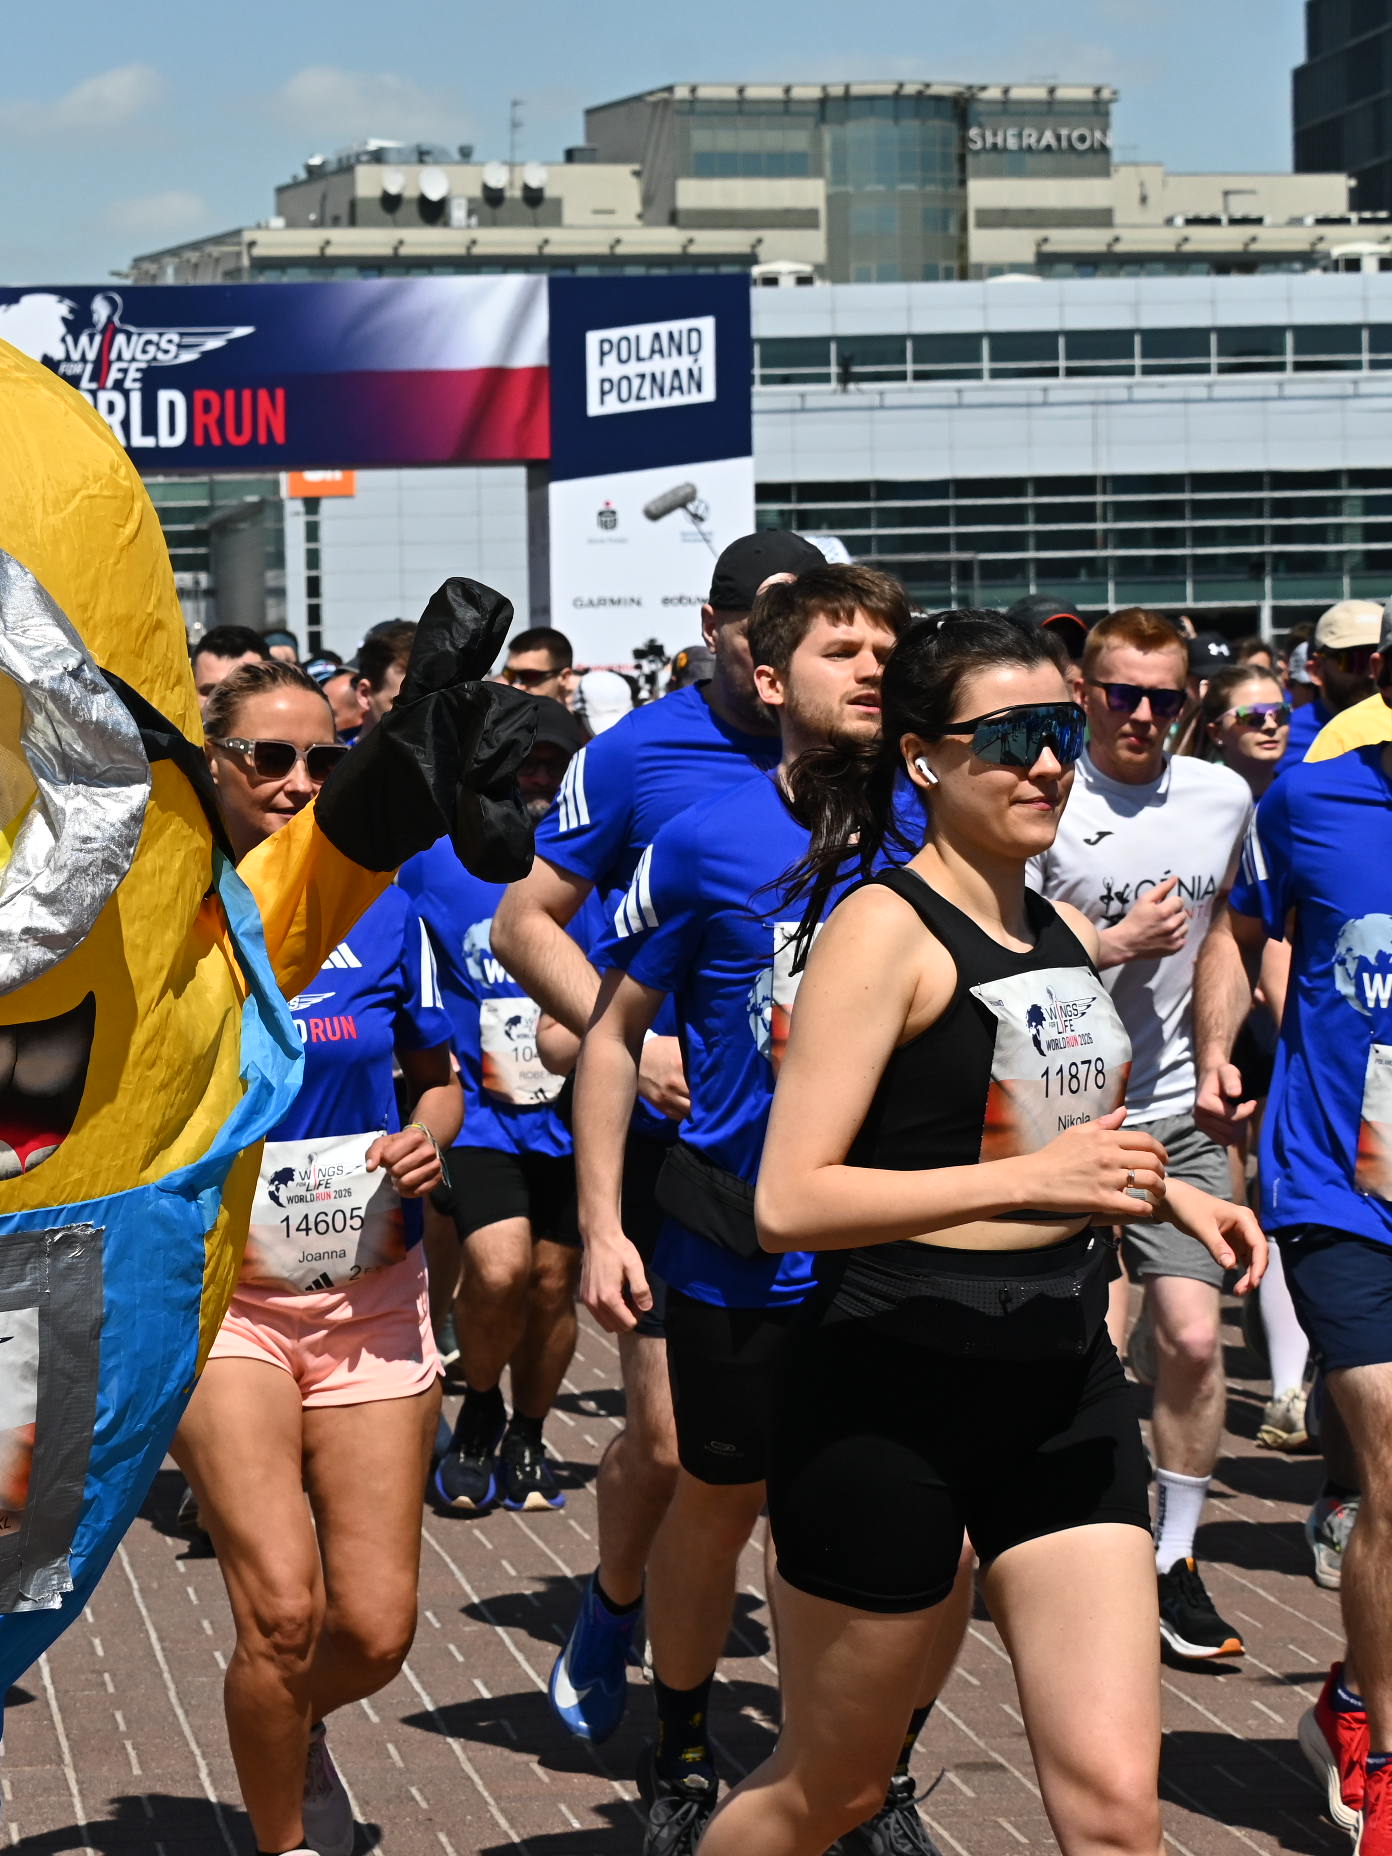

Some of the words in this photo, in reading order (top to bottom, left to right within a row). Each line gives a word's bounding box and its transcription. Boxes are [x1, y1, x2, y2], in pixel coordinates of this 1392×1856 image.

[967, 126, 1112, 151] SHERATON
[63, 331, 181, 361] WINGS
[599, 327, 702, 367] POLAND
[79, 361, 149, 390] LIFE
[600, 358, 703, 406] POZNAŃ
[79, 388, 187, 448] RLD
[193, 387, 286, 447] RUN
[309, 1015, 357, 1043] RUN
[1041, 1056, 1106, 1098] 11878
[298, 1165, 344, 1181] WINGS
[306, 1178, 333, 1192] LIFE
[286, 1192, 315, 1204] WORLD
[315, 1191, 332, 1201] RUN
[333, 1187, 352, 1200] 2026
[280, 1206, 364, 1238] 14605
[298, 1249, 346, 1263] Joanna
[348, 1264, 362, 1281] 2
